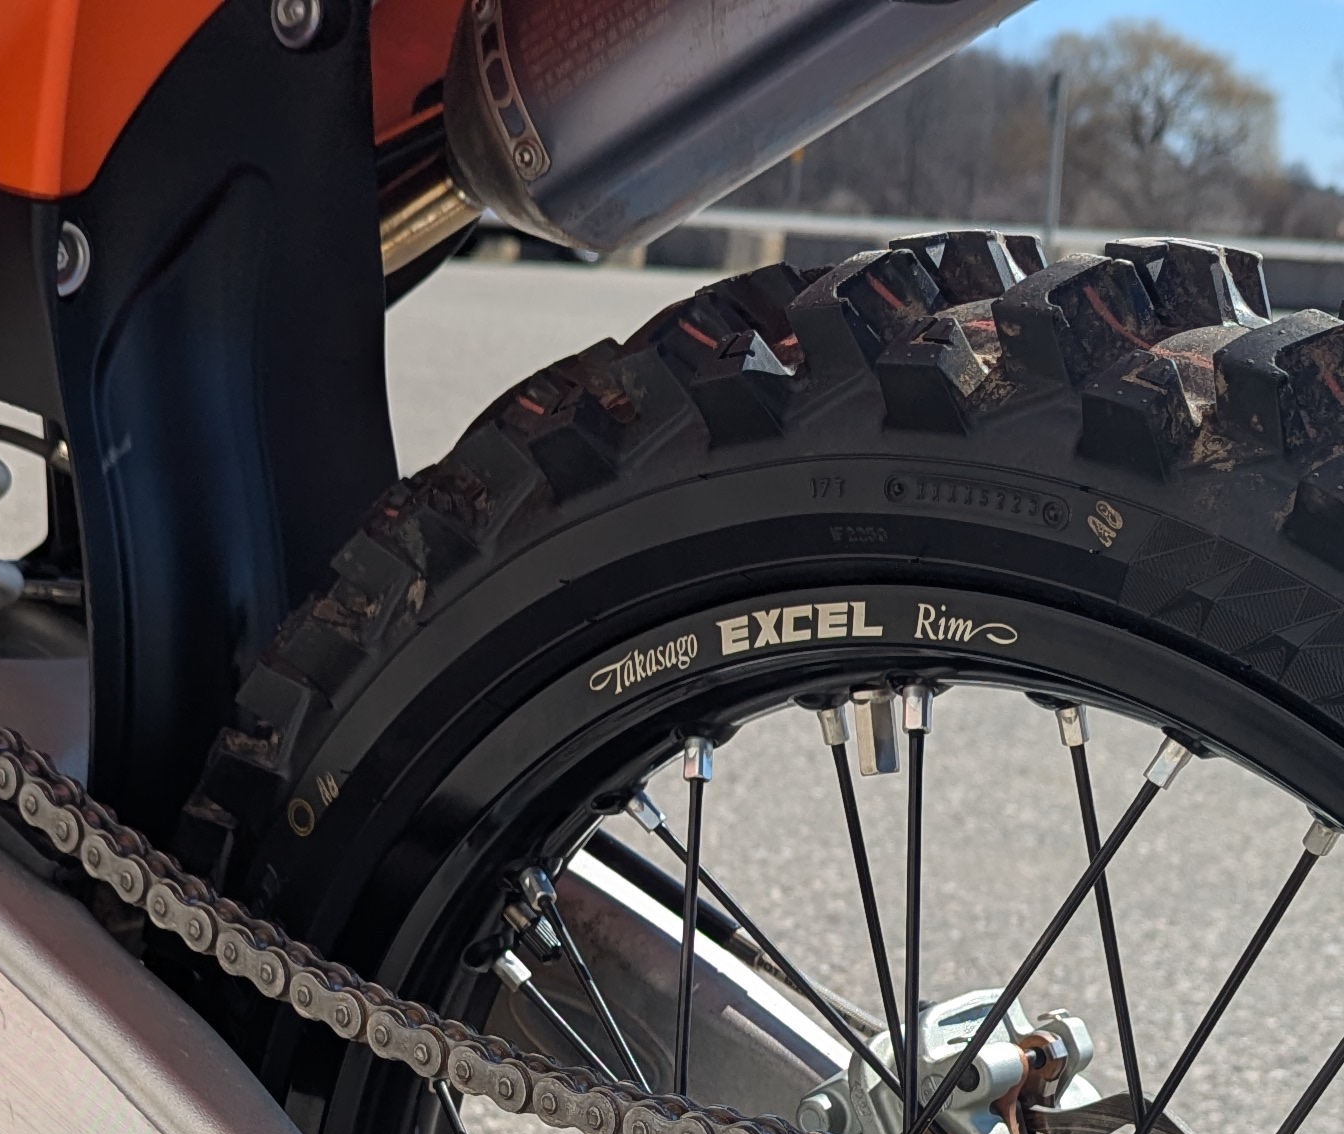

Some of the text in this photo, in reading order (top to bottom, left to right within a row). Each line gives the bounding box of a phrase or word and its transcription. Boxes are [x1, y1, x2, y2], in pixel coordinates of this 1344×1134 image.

[589, 601, 1019, 696] Takasago EXCEL Rim
